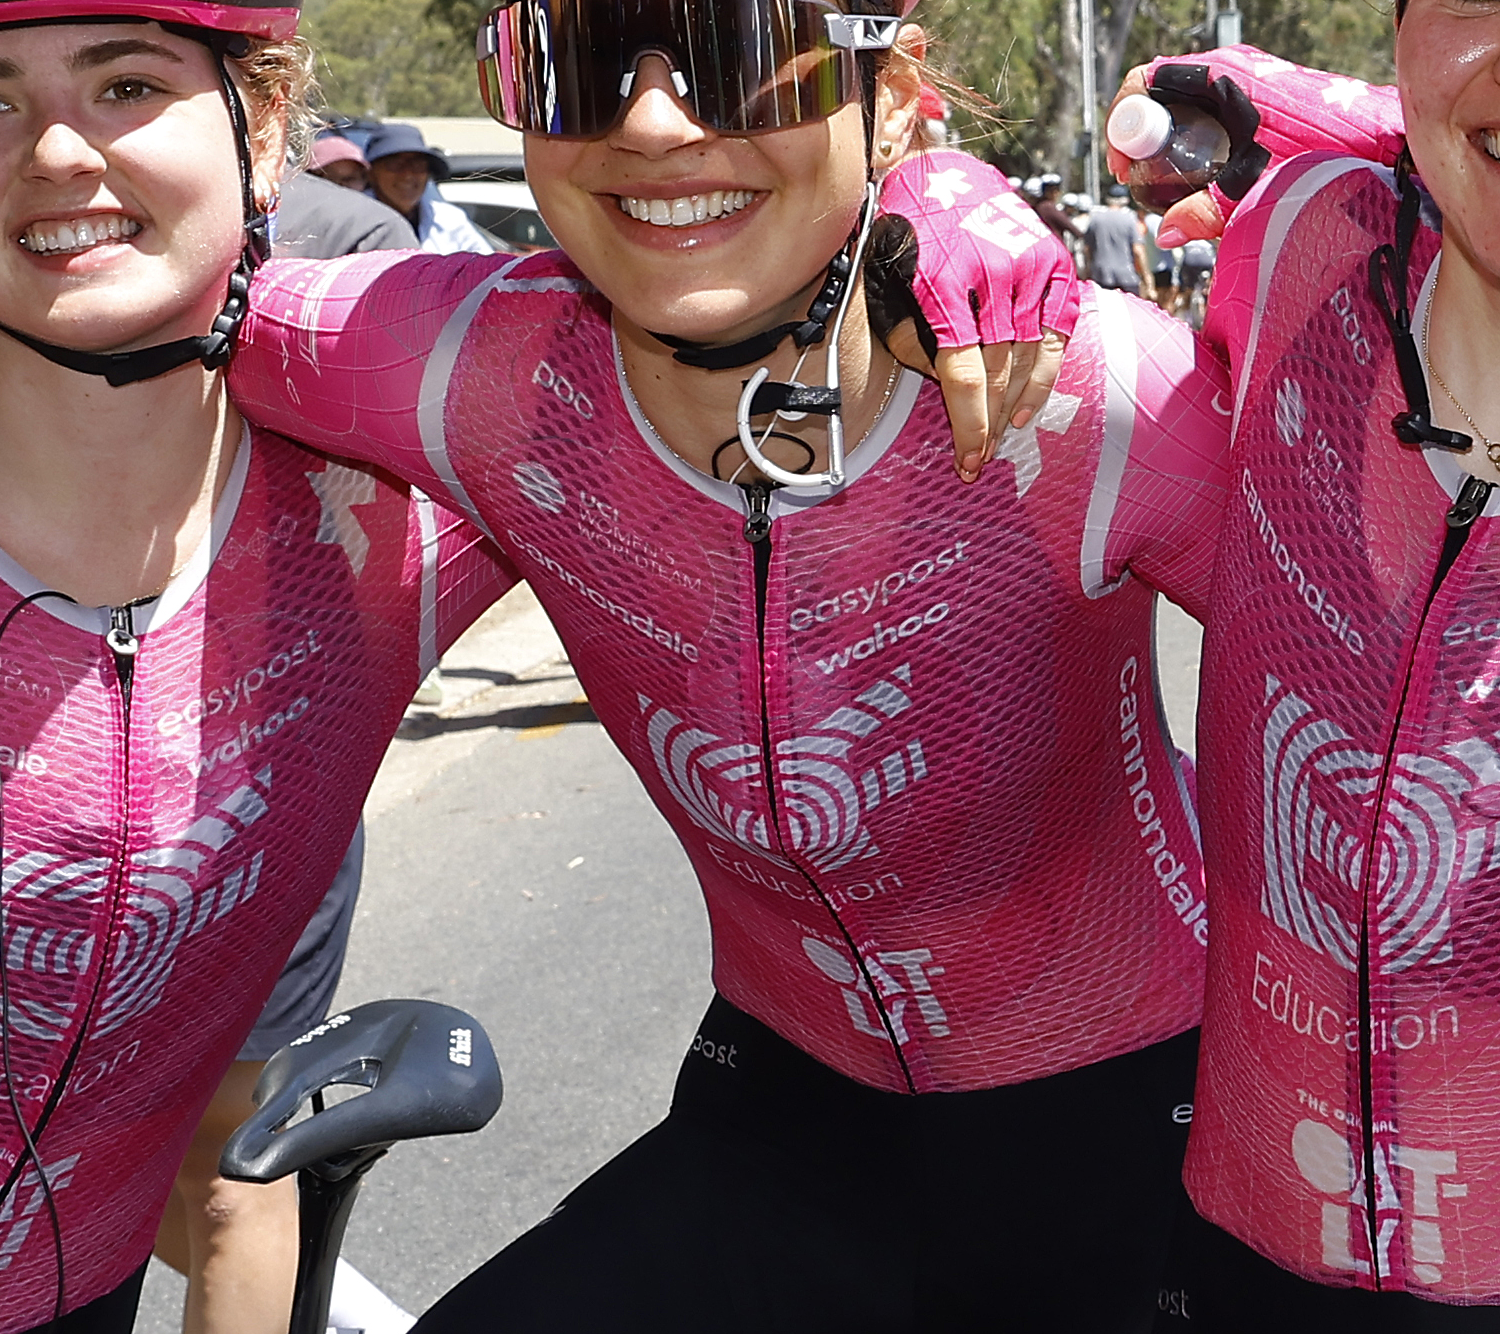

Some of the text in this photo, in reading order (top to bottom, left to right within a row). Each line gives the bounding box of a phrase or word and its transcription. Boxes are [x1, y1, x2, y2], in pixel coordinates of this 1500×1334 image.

[1330, 285, 1372, 366] poc
[506, 528, 699, 665] cannondale
[789, 539, 973, 632] easypost
[1241, 467, 1365, 656] cannondale
[156, 626, 323, 738] easypost
[814, 602, 951, 676] wahoo
[188, 694, 310, 779] wahoo
[1118, 654, 1209, 947] cannondale
[1251, 950, 1461, 1056] Education
